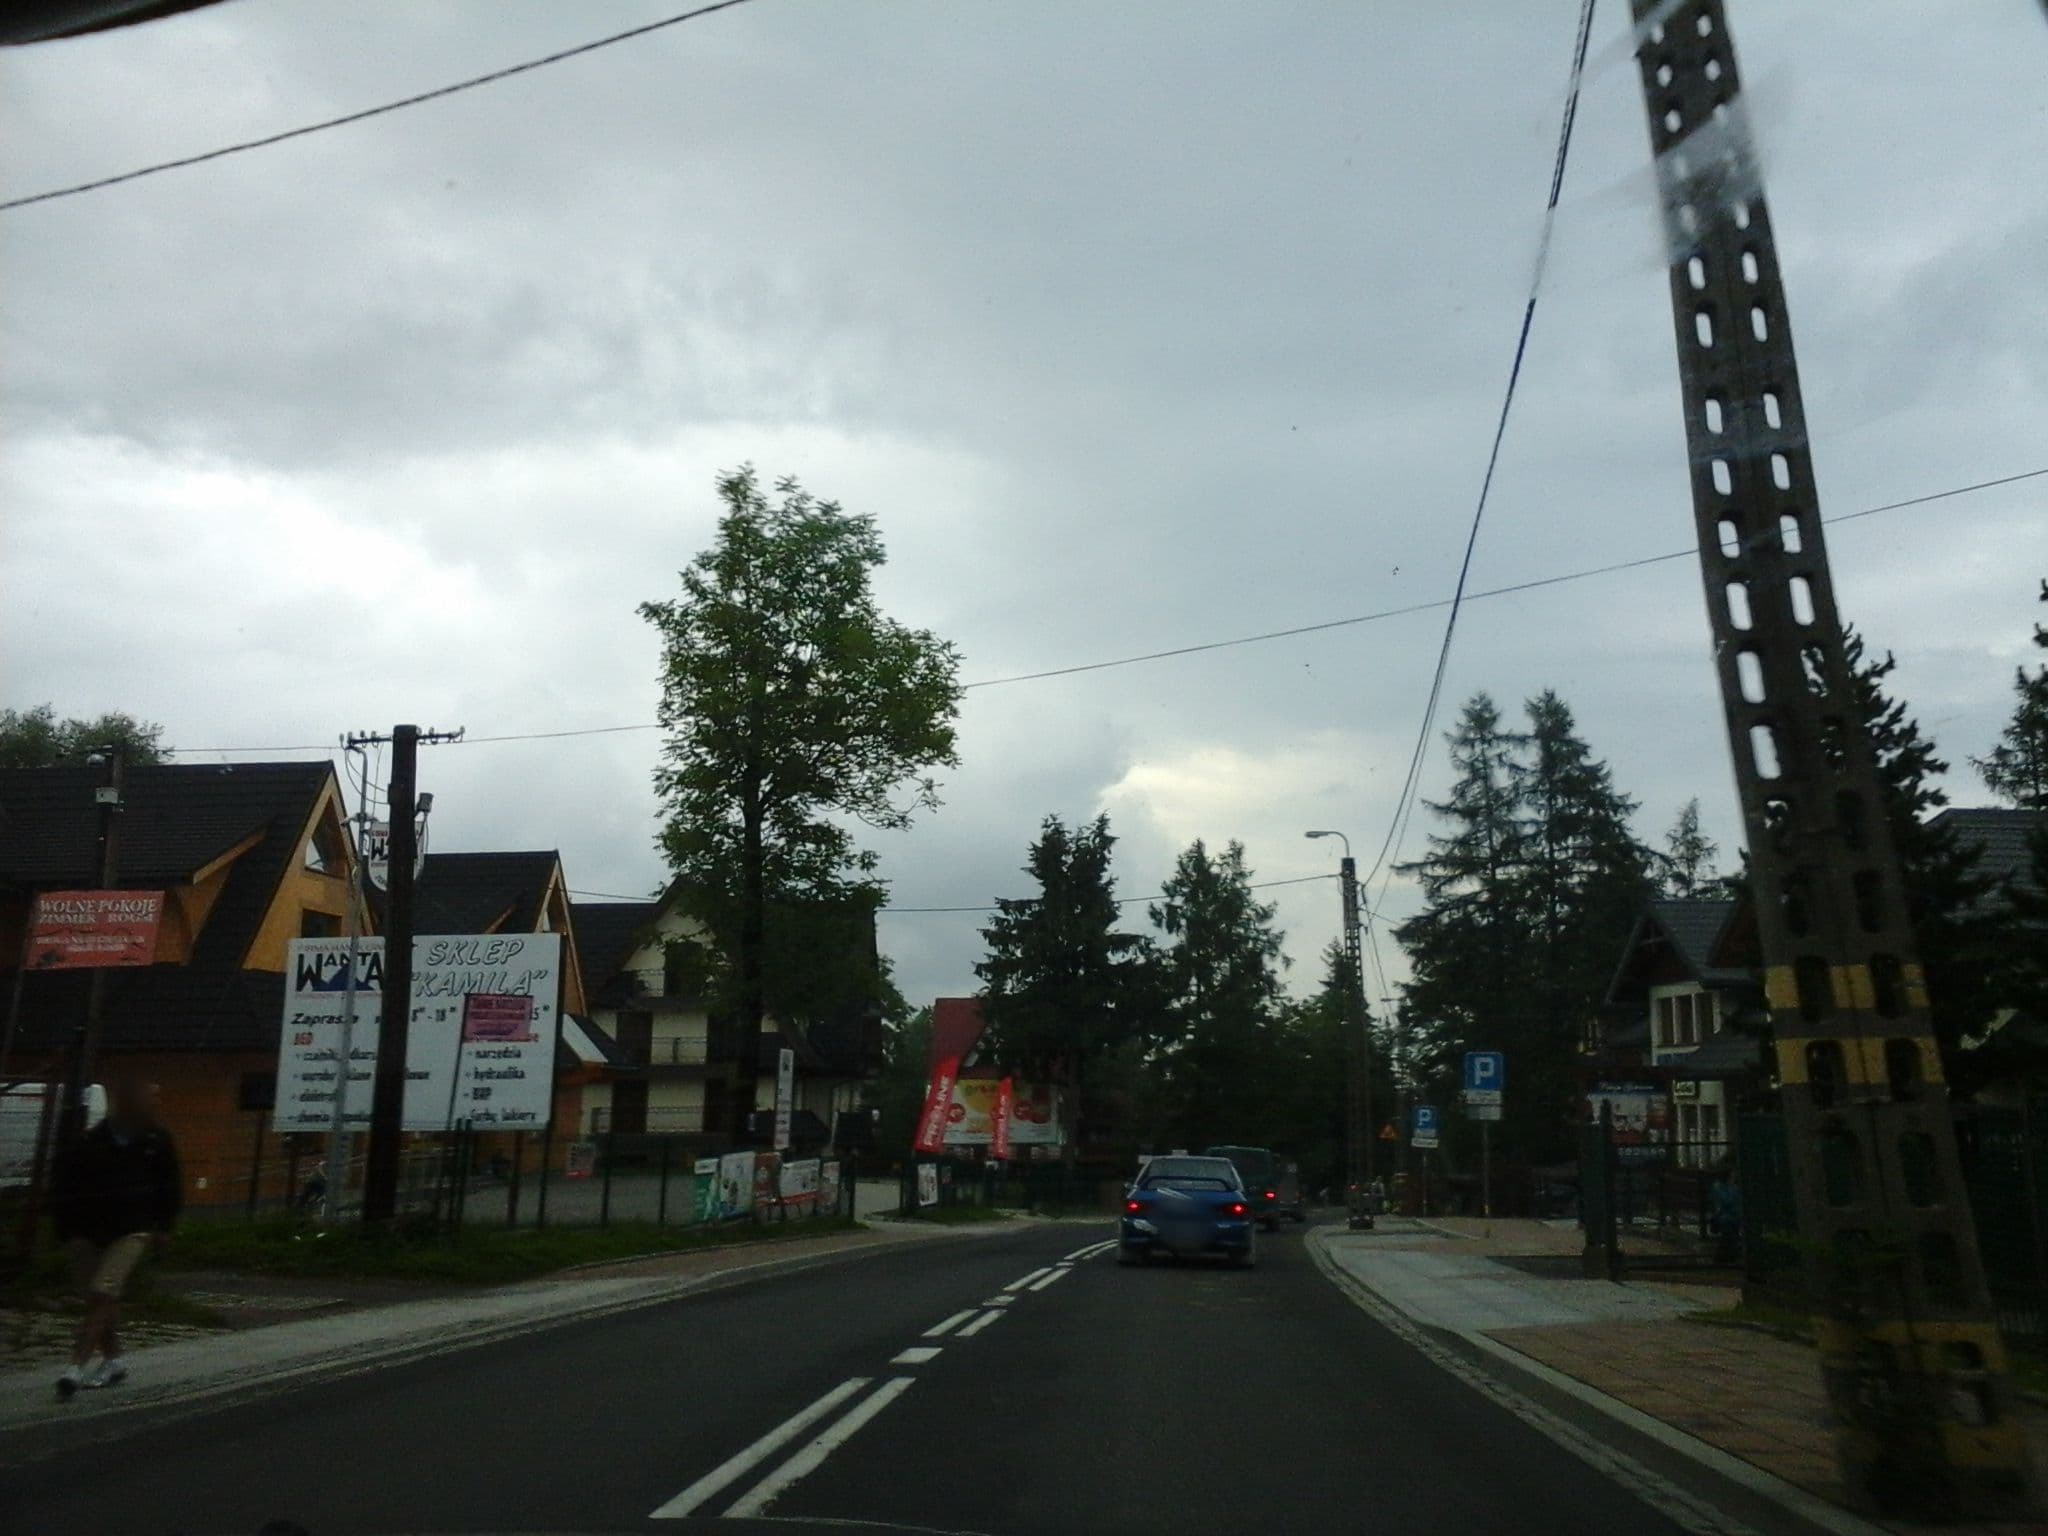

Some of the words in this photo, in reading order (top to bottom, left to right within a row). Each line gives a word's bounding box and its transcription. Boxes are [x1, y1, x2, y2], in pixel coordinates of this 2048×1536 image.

[40, 900, 97, 912] WOLNE
[97, 899, 158, 913] POKOJE
[427, 939, 525, 966] SKLEP
[1474, 1057, 1494, 1085] P
[1419, 1108, 1433, 1126] P
